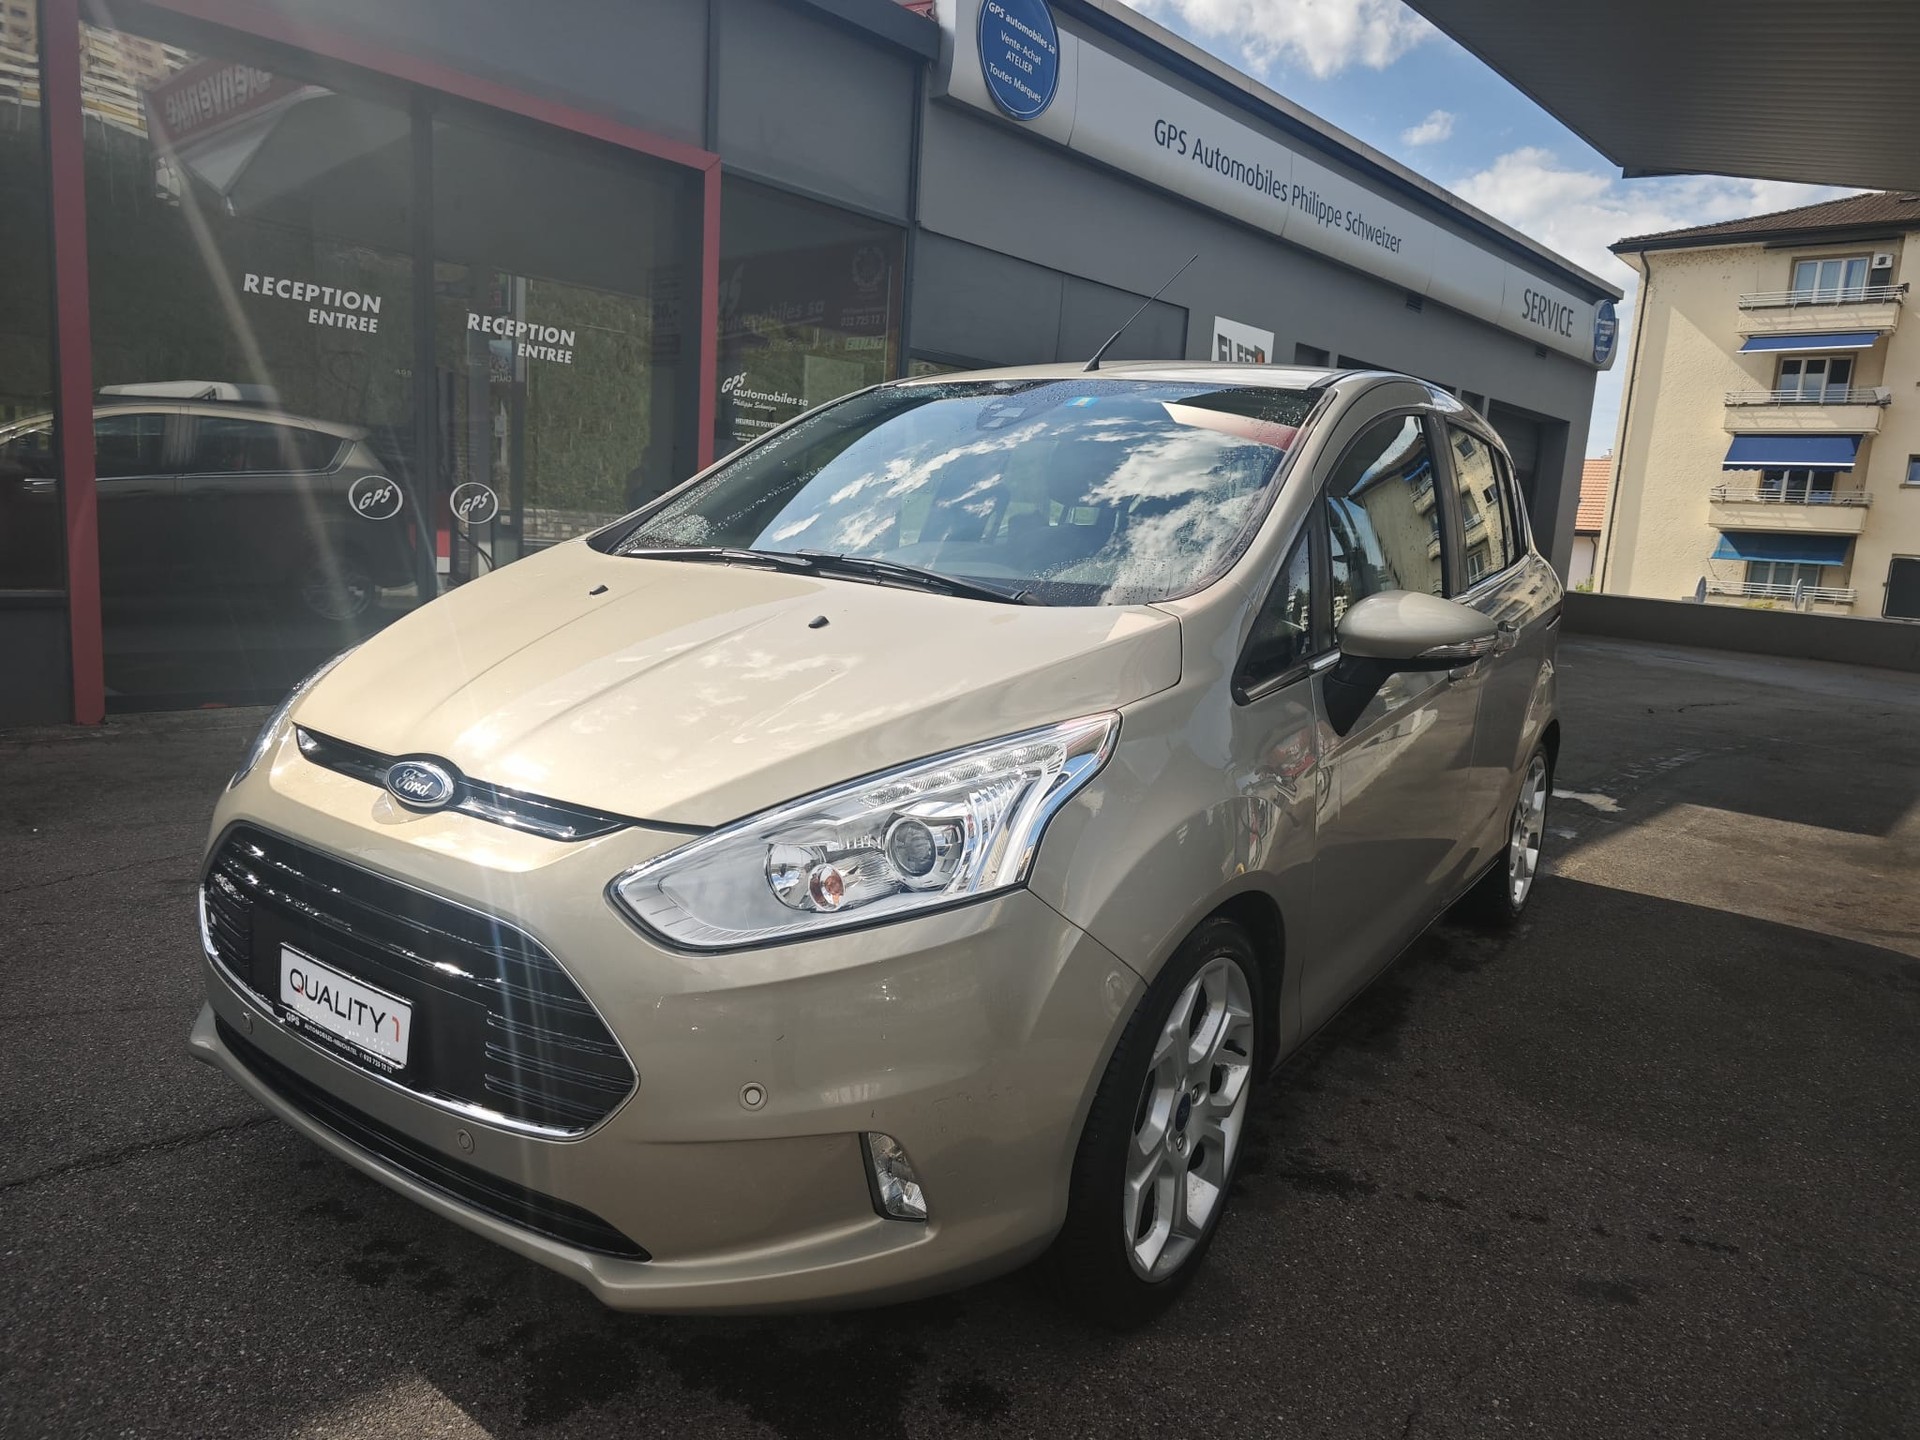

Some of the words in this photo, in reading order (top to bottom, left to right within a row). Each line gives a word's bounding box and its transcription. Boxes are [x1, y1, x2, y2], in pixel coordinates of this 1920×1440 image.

[988, 1, 1005, 19] GPS
[1005, 14, 1048, 49] automobiles
[1048, 43, 1056, 55] sa
[1000, 30, 1042, 66] Vente-Achat
[1005, 50, 1033, 75] ATELIER
[989, 62, 1013, 85] Toutes
[1013, 77, 1042, 103] Marques
[1154, 119, 1187, 156] GPS
[1192, 138, 1287, 202] Automobiles
[1291, 184, 1342, 228] Philippe
[1344, 211, 1402, 254] Schweizer
[243, 273, 381, 314] RECEPTION
[308, 308, 378, 334] ENTREE
[1522, 288, 1574, 338] SERVICE
[467, 312, 576, 346] RECEPTION
[517, 343, 573, 364] ENTREE
[721, 372, 747, 393] GPS
[733, 389, 797, 405] automobiles
[798, 398, 809, 406] sa
[358, 485, 393, 510] GPS
[459, 491, 490, 515] GPS
[395, 768, 434, 797] Ford
[290, 968, 387, 1033] QUALITY
[285, 1011, 300, 1027] GPS
